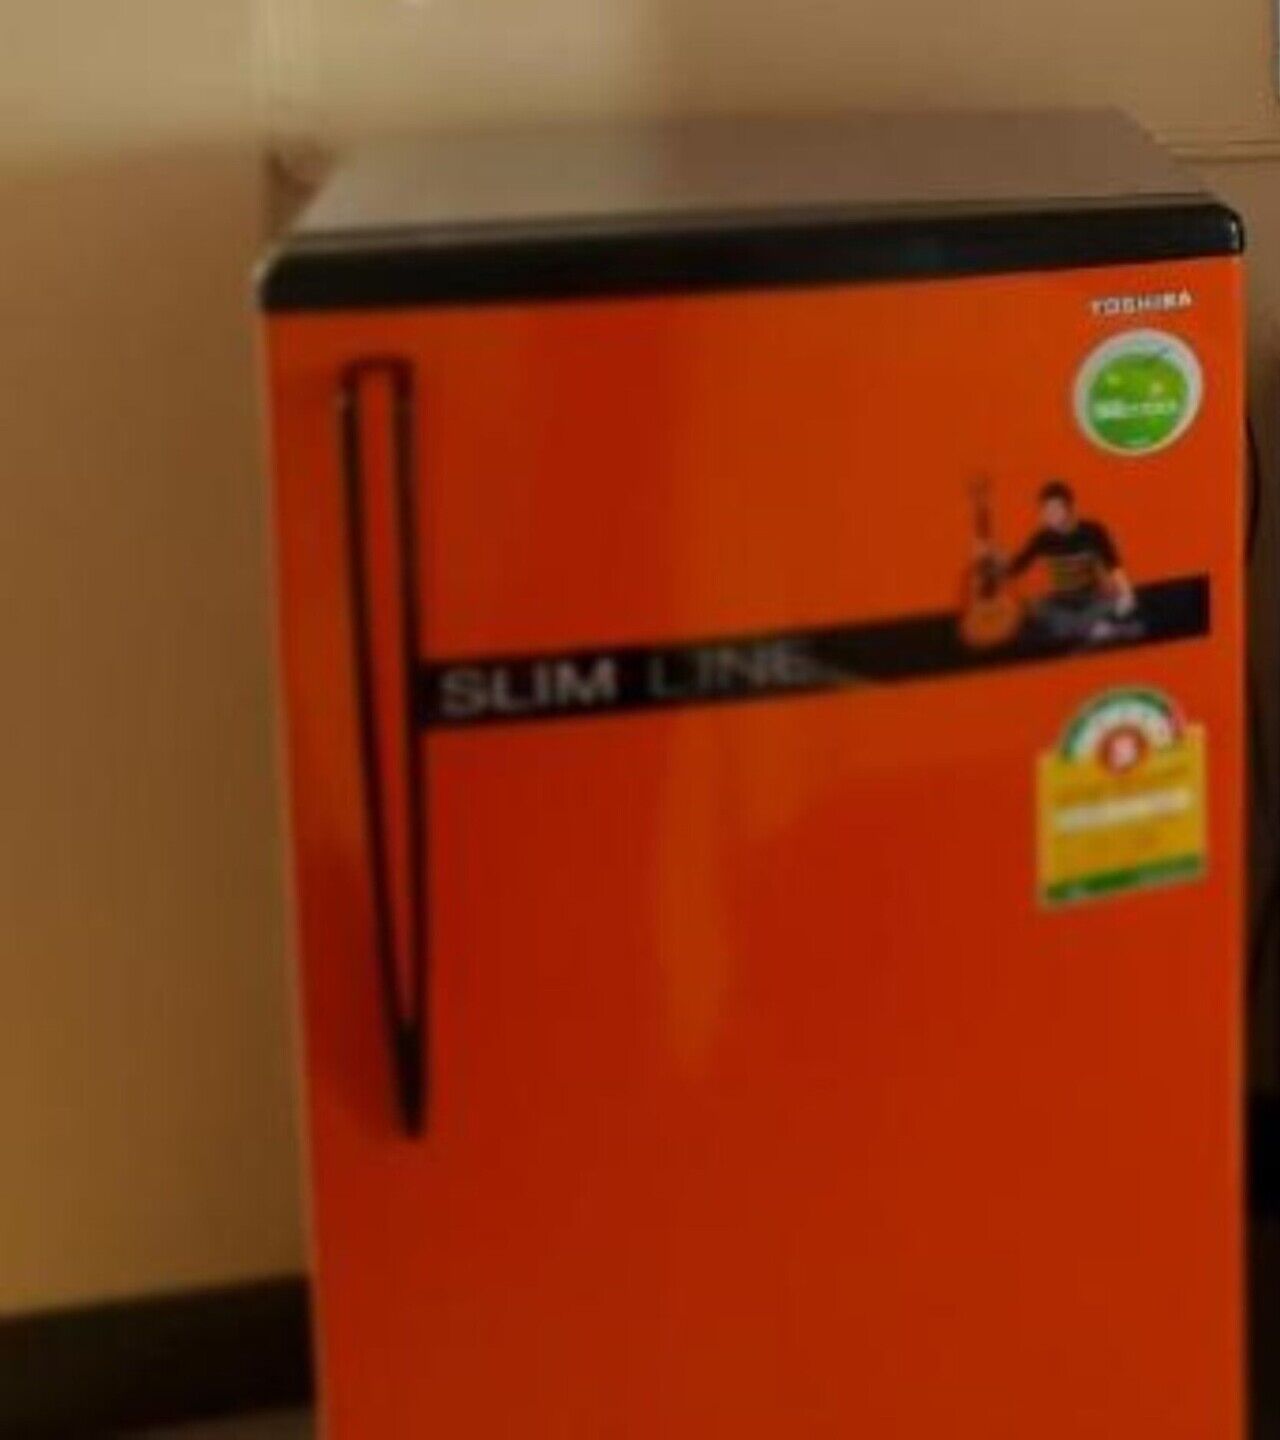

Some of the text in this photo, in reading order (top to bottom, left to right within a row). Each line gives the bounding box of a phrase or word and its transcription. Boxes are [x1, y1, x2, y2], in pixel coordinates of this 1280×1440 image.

[1091, 289, 1193, 315] TOSHIBA
[440, 640, 818, 718] SLIM LINE
